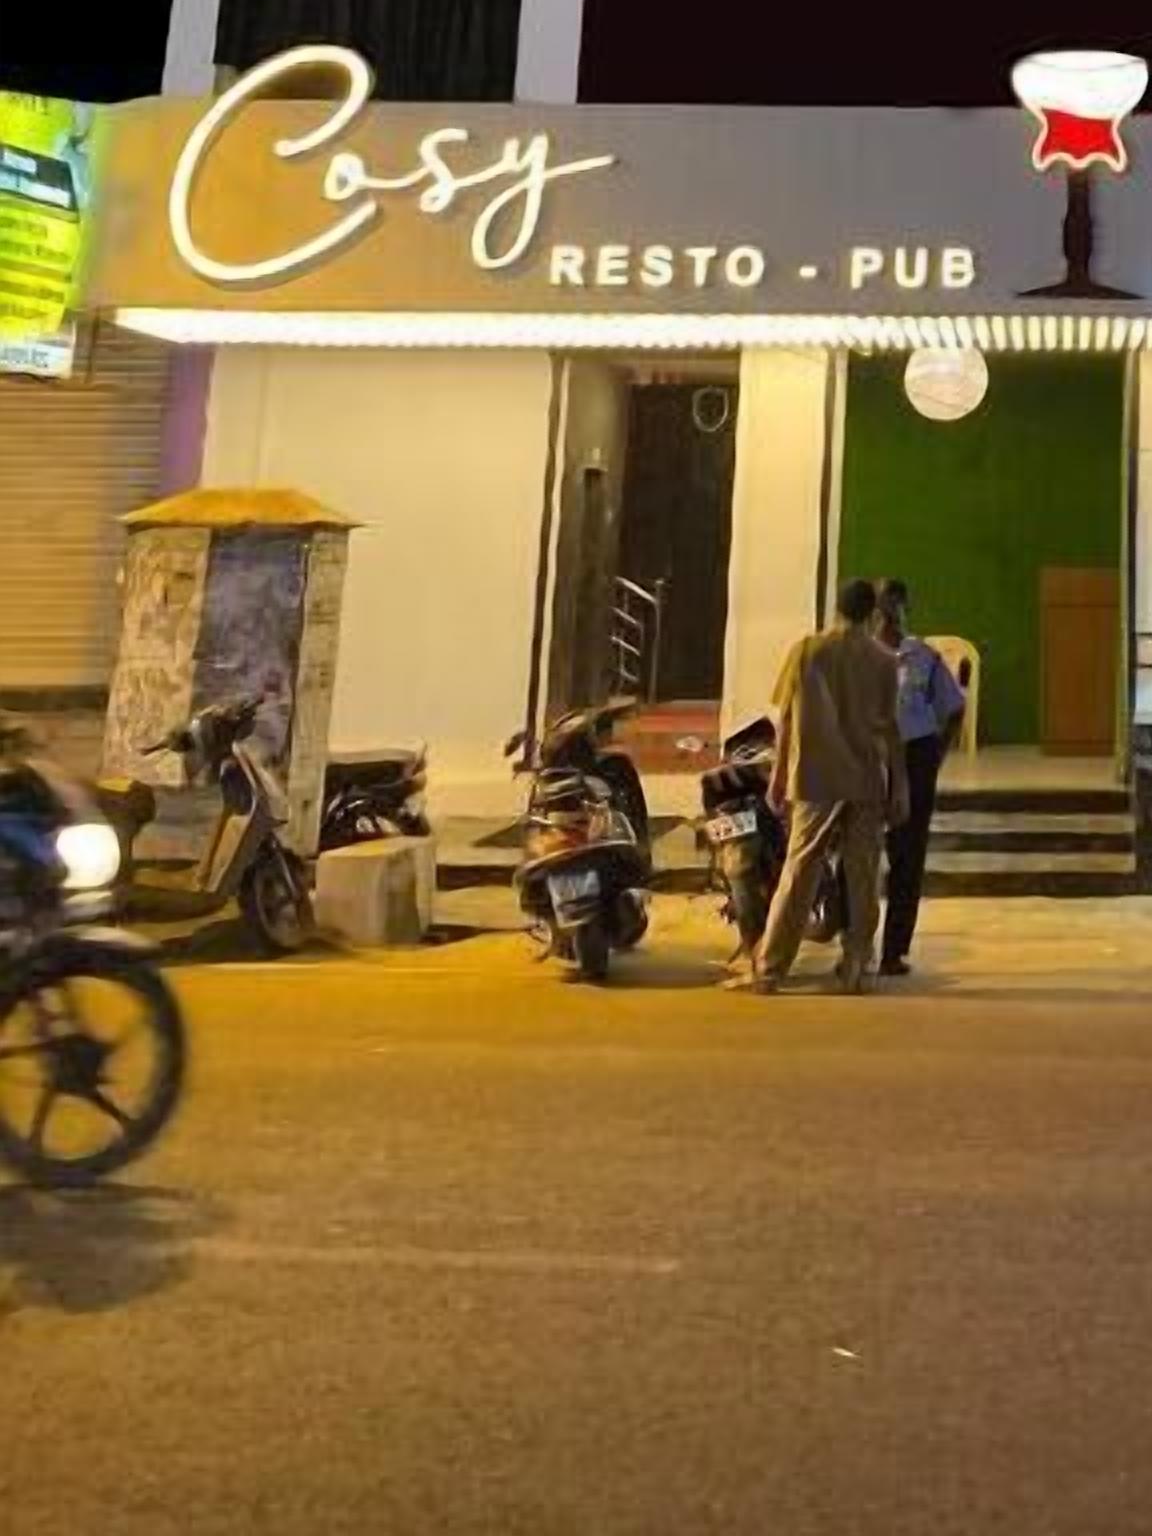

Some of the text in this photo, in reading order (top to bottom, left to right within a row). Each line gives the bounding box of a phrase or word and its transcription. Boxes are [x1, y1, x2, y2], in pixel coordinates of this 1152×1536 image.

[167, 44, 616, 281] Cosy
[548, 244, 766, 287] RESTO
[849, 246, 976, 290] PUB
